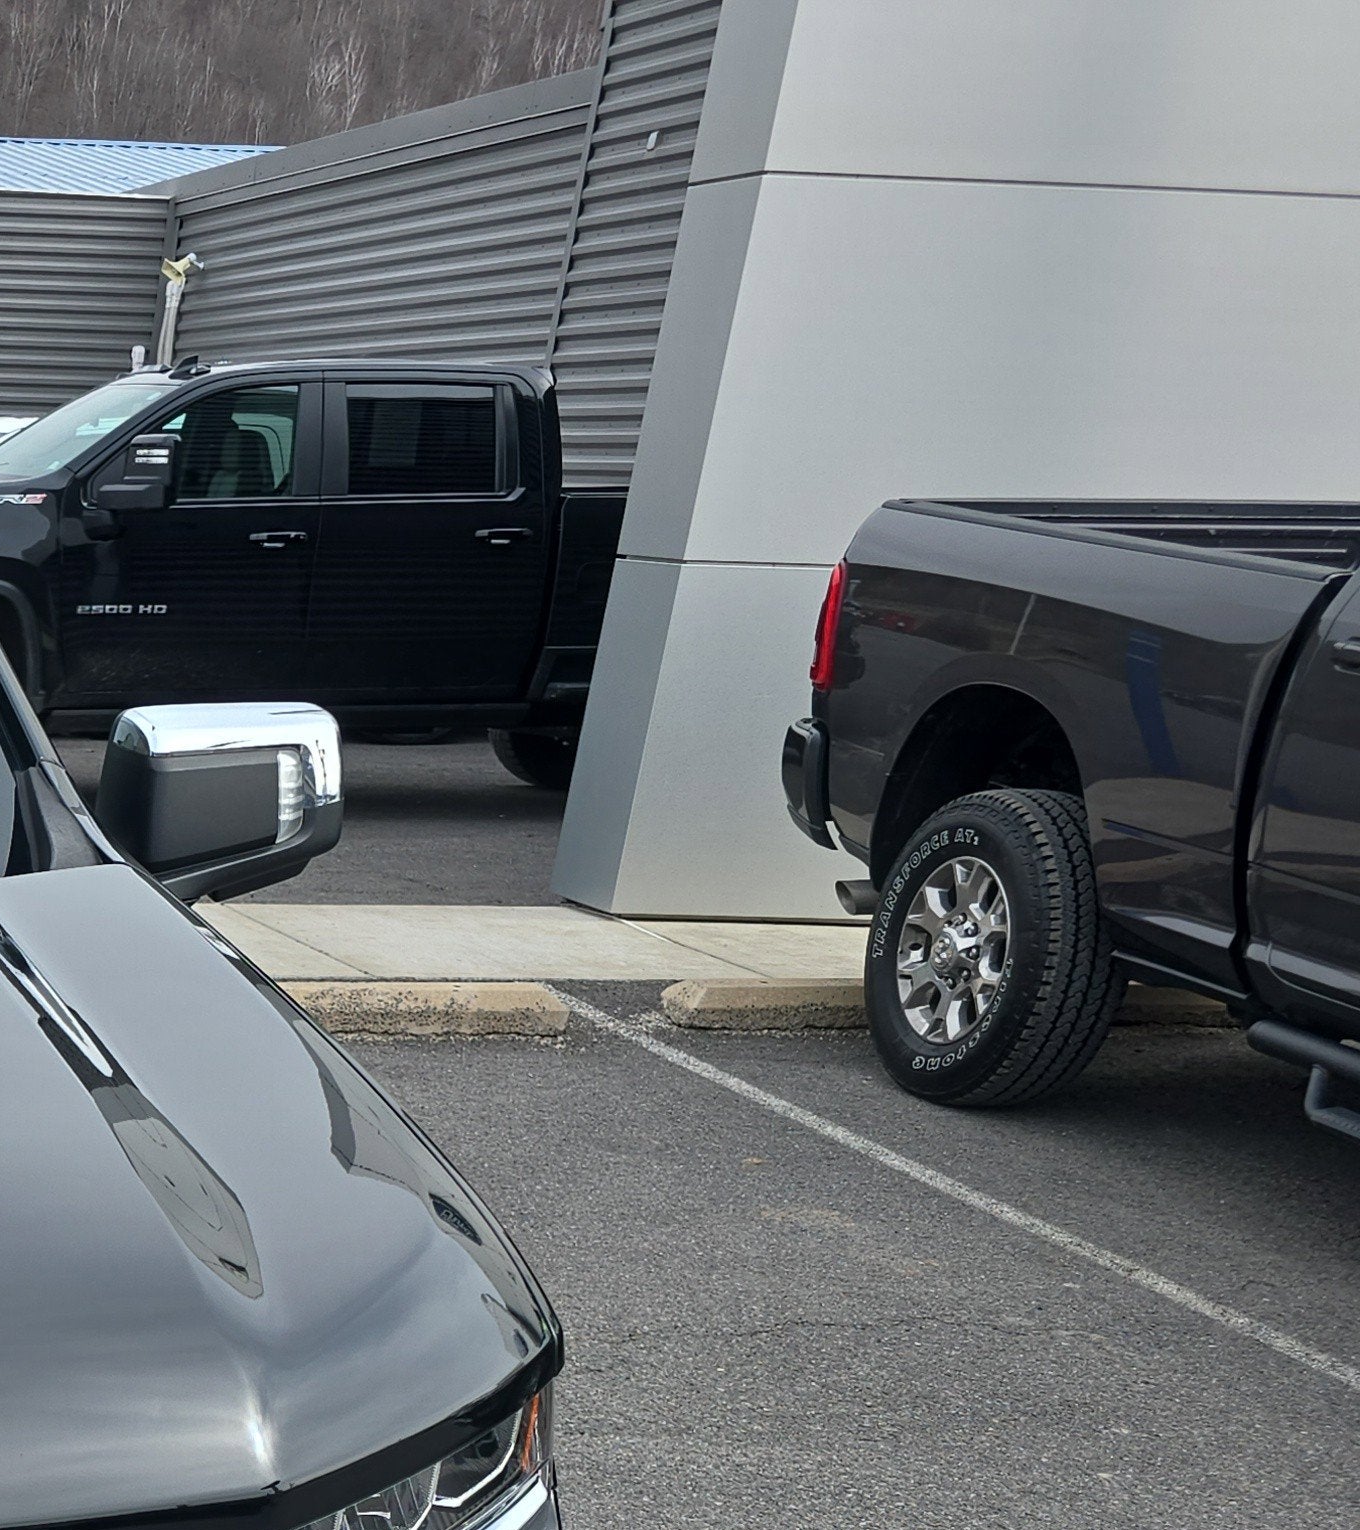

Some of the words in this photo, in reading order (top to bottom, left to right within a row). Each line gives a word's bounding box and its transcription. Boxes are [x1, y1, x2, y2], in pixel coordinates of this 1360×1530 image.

[77, 604, 133, 614] 2500
[138, 604, 168, 614] HD
[872, 830, 949, 959] TRANSFORCE
